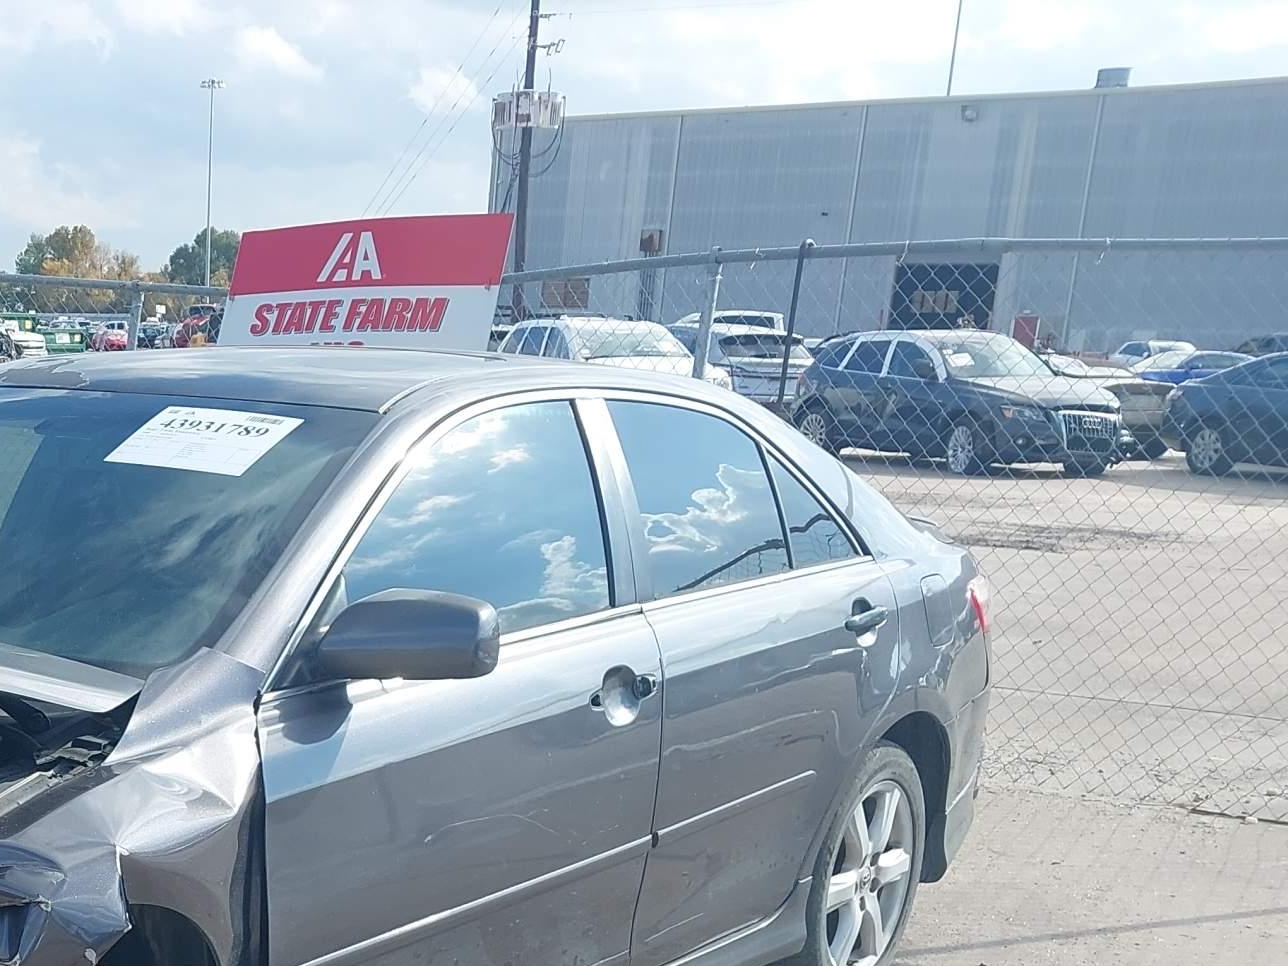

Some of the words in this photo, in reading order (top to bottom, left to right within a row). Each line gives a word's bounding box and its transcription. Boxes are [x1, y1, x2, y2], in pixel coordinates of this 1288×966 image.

[249, 298, 345, 338] STATE
[342, 297, 450, 333] FARM
[159, 417, 269, 438] 43931789
